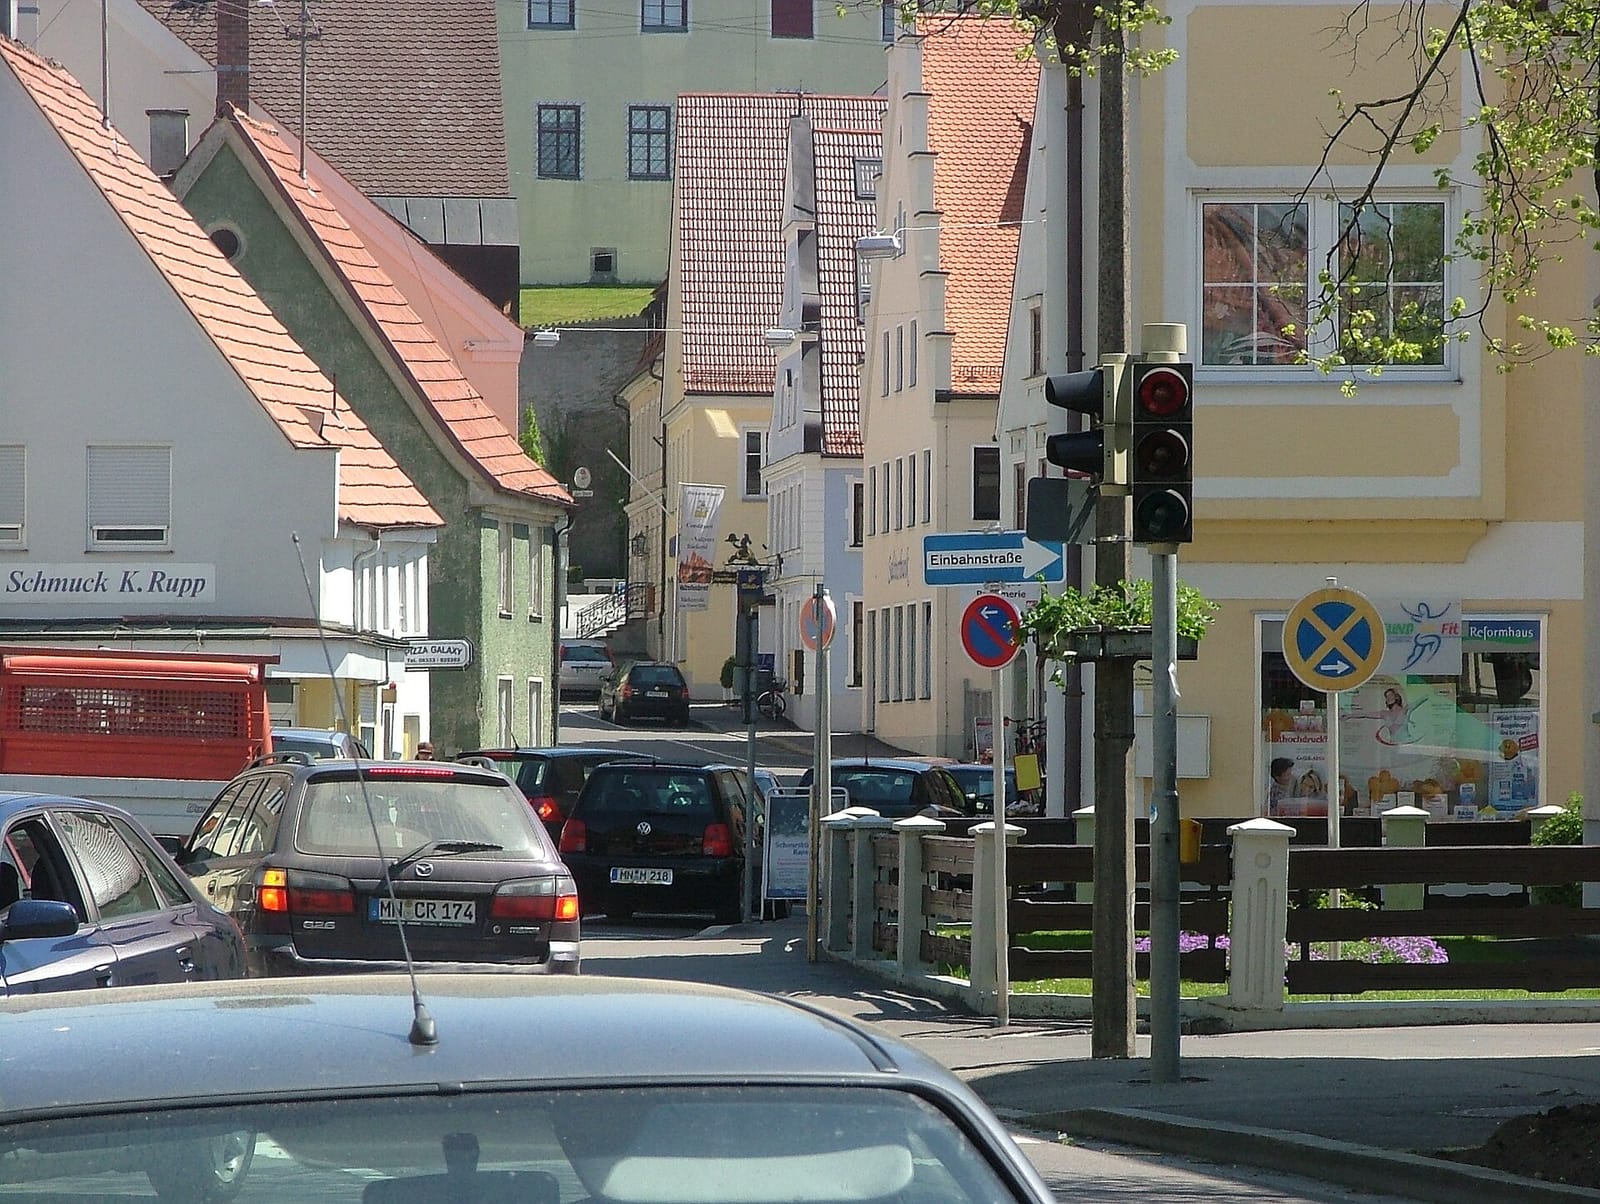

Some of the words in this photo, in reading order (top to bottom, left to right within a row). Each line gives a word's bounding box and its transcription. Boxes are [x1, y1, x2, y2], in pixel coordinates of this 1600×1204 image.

[930, 552, 1022, 566] Einbahnstraße
[6, 570, 109, 593] Schmuck
[119, 570, 143, 593] K.
[147, 570, 206, 598] Rupp
[1441, 622, 1460, 635] Fit
[1469, 626, 1534, 641] Reformhaus
[404, 646, 428, 656] PIZZA
[431, 645, 462, 655] GALAXY
[620, 870, 634, 880] MN
[650, 871, 669, 881] 218
[380, 901, 403, 918] MN
[414, 902, 437, 919] CR
[441, 903, 474, 920] 174
